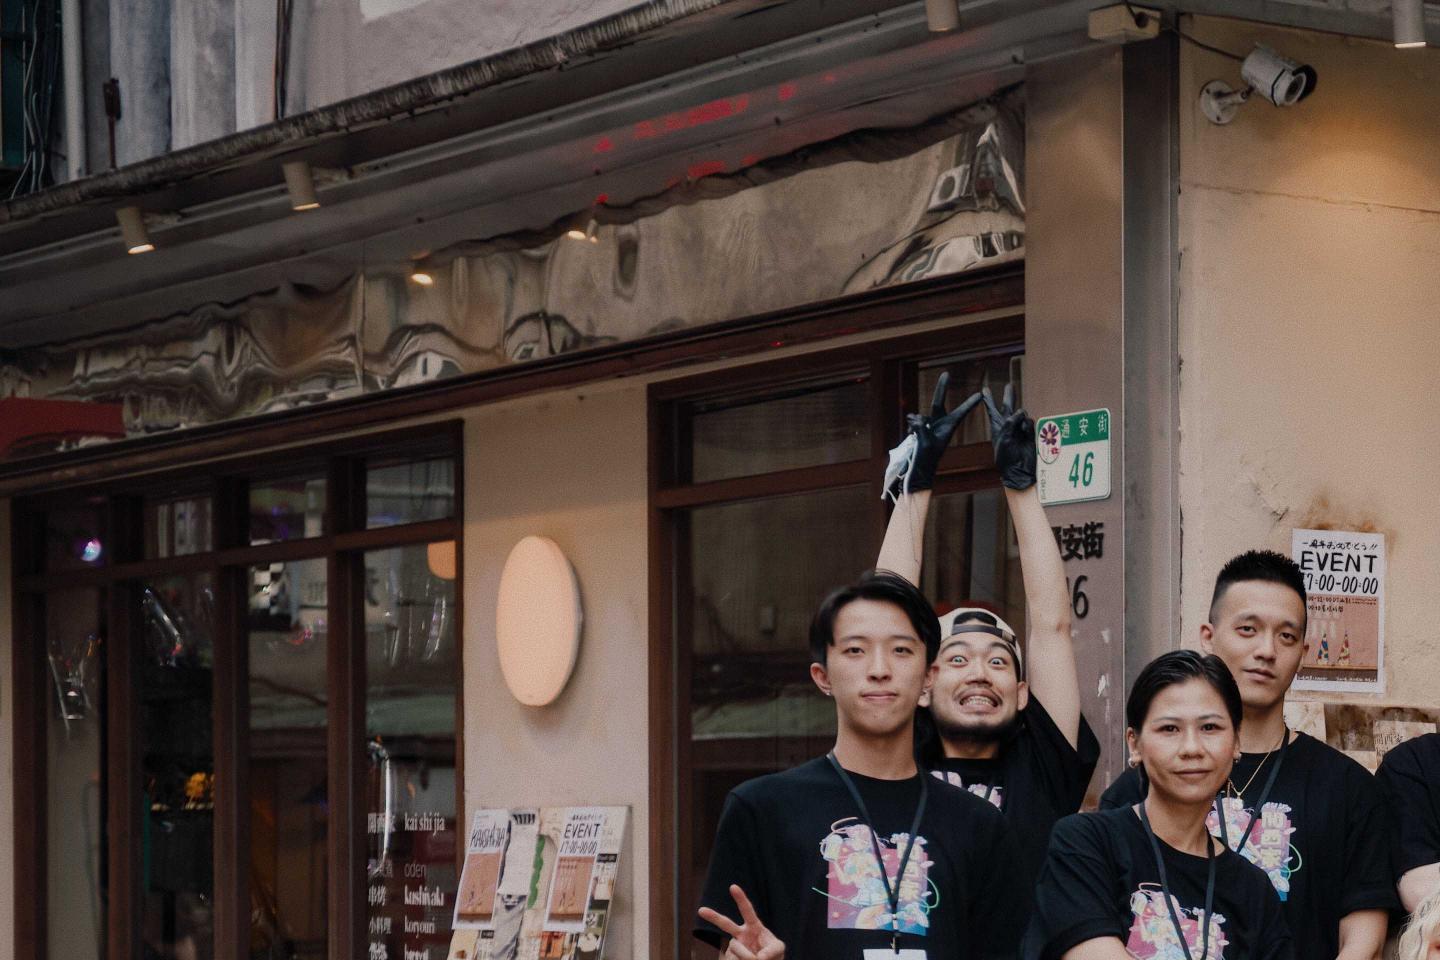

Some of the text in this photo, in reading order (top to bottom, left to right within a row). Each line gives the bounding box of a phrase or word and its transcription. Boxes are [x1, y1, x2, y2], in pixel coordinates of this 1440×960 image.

[1069, 451, 1094, 489] 46
[1051, 521, 1105, 561] 安街
[1300, 550, 1378, 573] EVENT
[1304, 572, 1379, 595] 7:00-00:00
[1065, 574, 1090, 620] 6
[404, 811, 445, 837] kai shi jia
[563, 823, 600, 839] EVENT
[403, 860, 427, 878] oden
